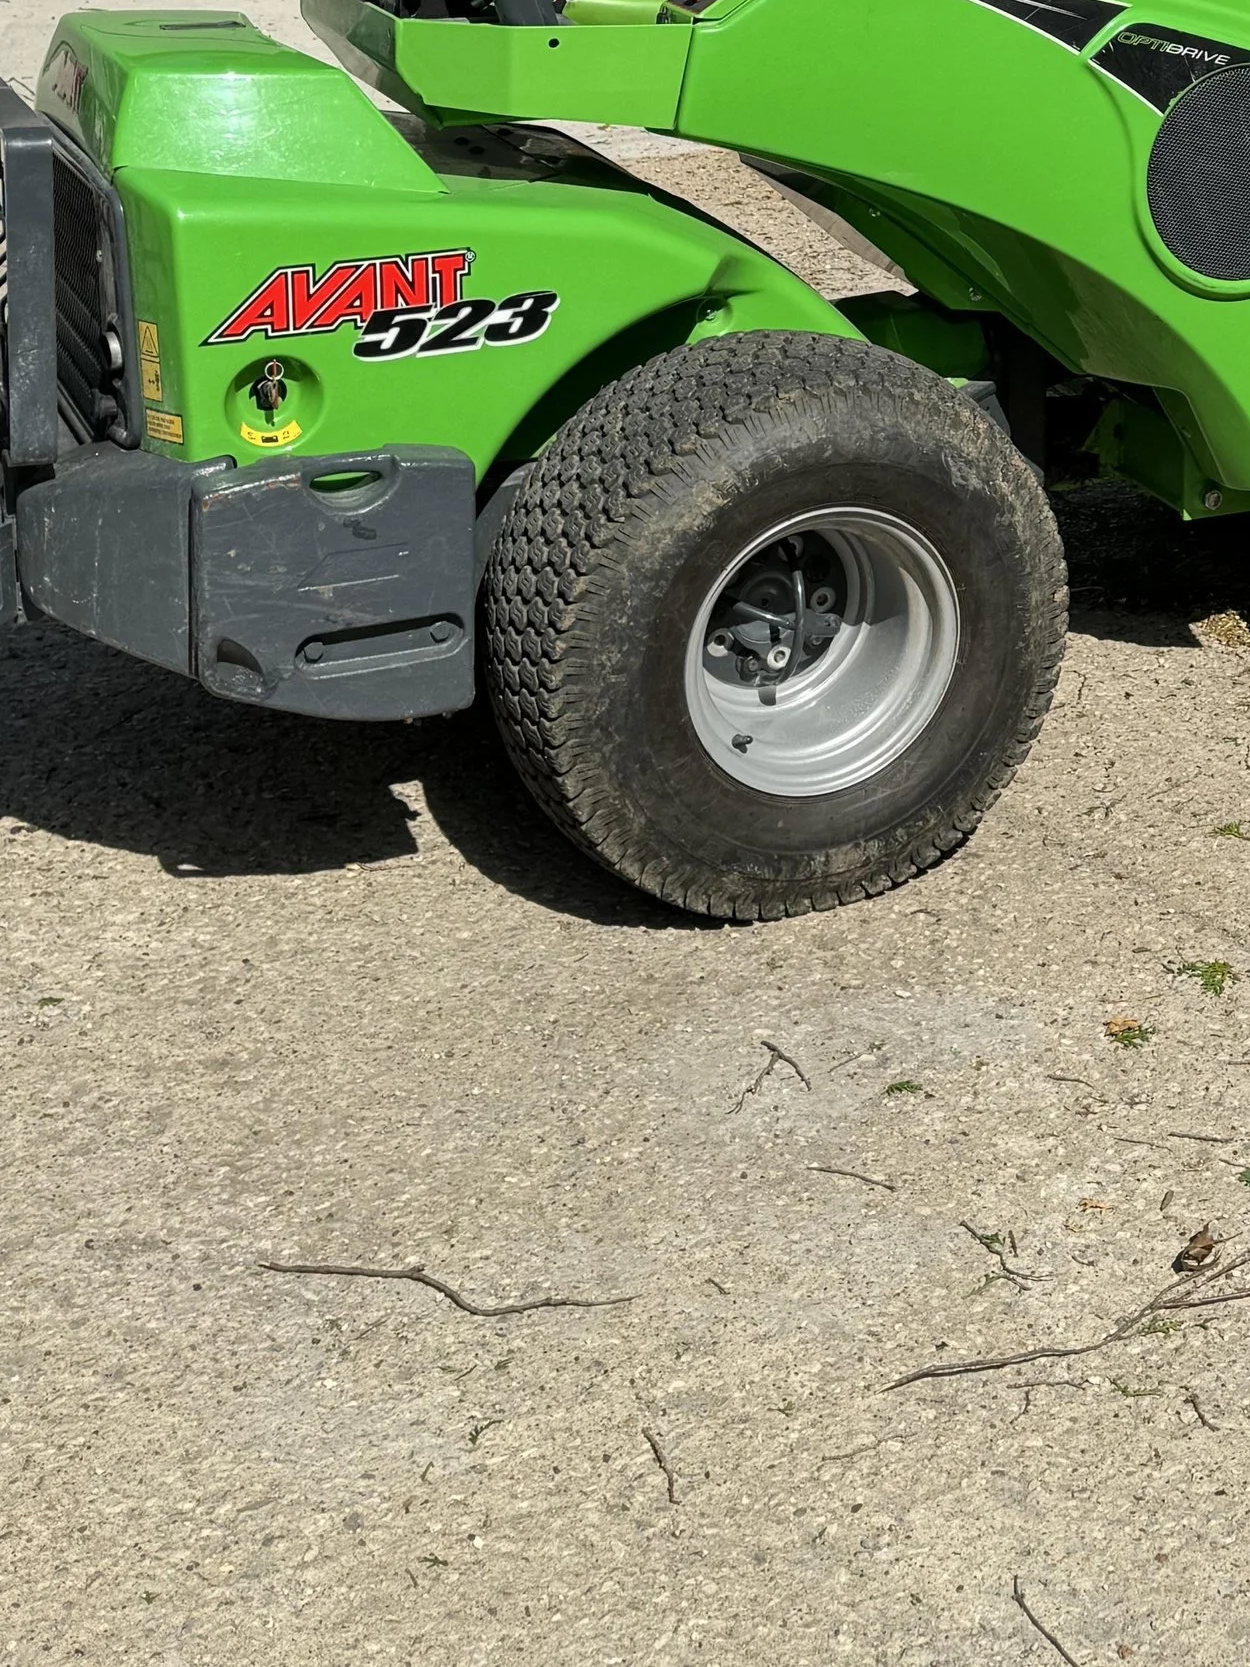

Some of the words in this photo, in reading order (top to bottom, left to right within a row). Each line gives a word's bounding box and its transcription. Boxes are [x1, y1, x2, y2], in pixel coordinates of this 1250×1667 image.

[1117, 31, 1231, 66] OPTIDRIVE
[203, 249, 470, 344] AVANT
[353, 291, 560, 362] 523
